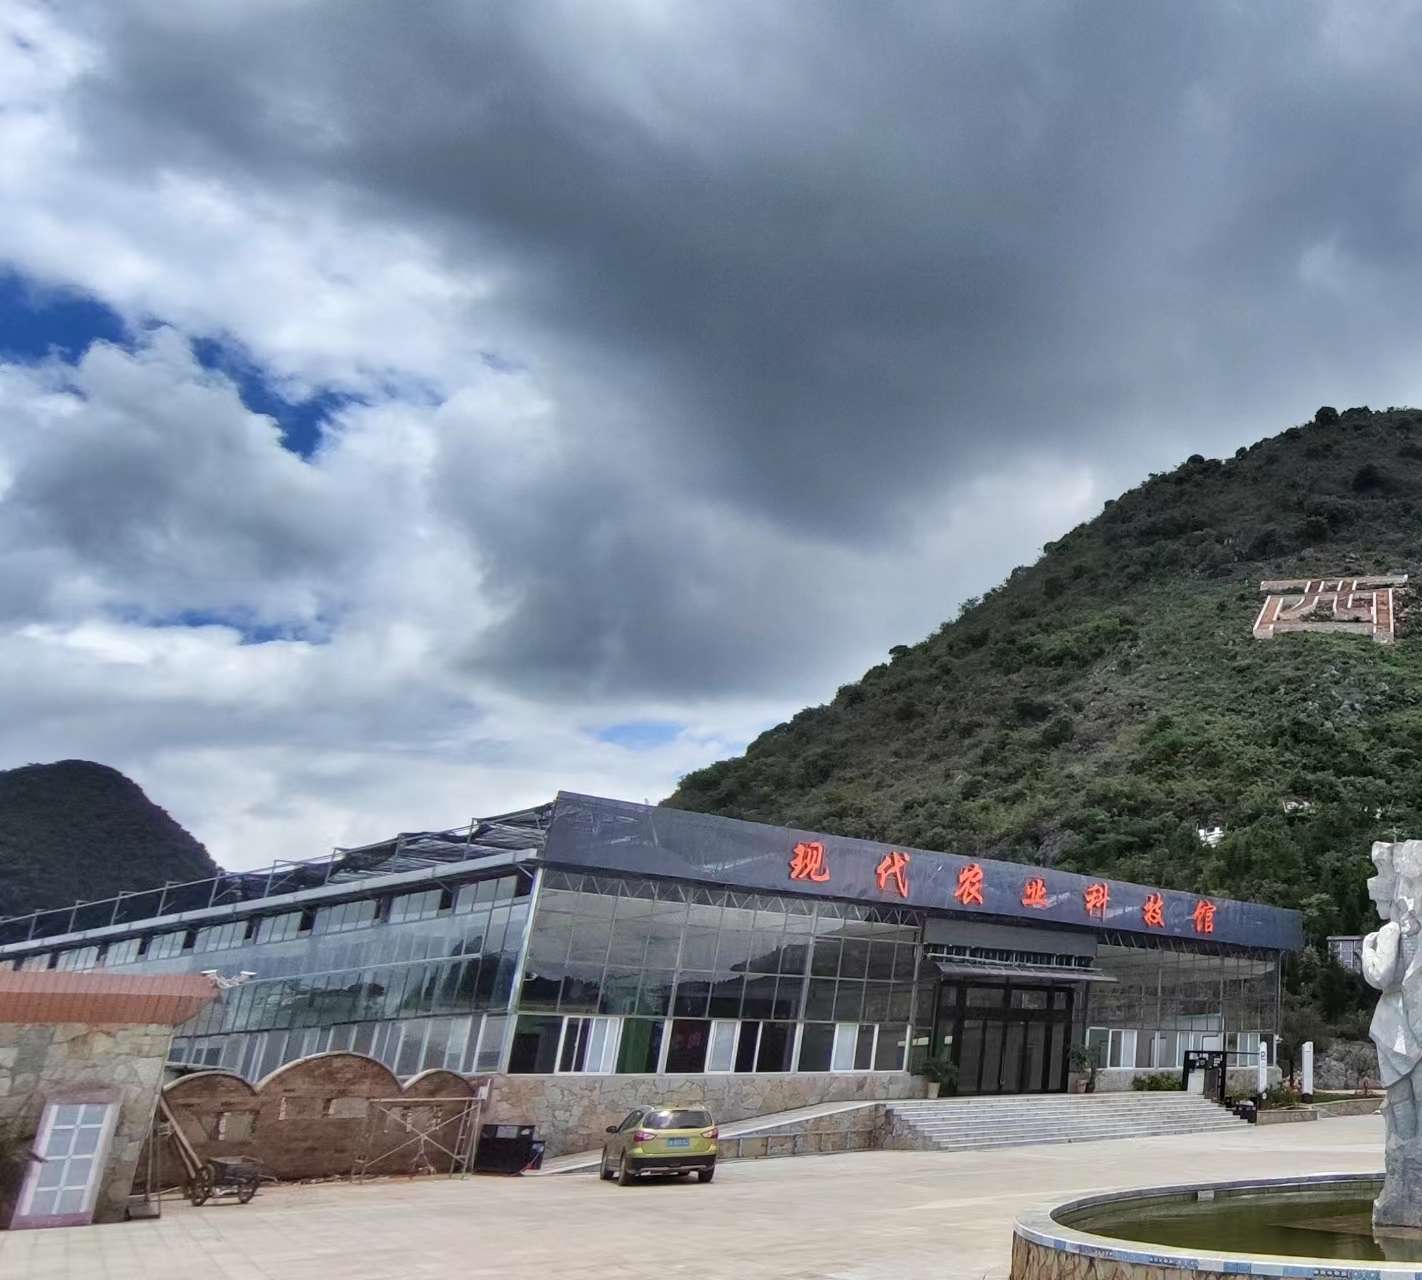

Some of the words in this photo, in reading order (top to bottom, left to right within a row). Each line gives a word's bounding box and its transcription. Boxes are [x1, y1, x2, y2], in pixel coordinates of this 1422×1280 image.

[789, 840, 1217, 933] 现代农业科技馆
